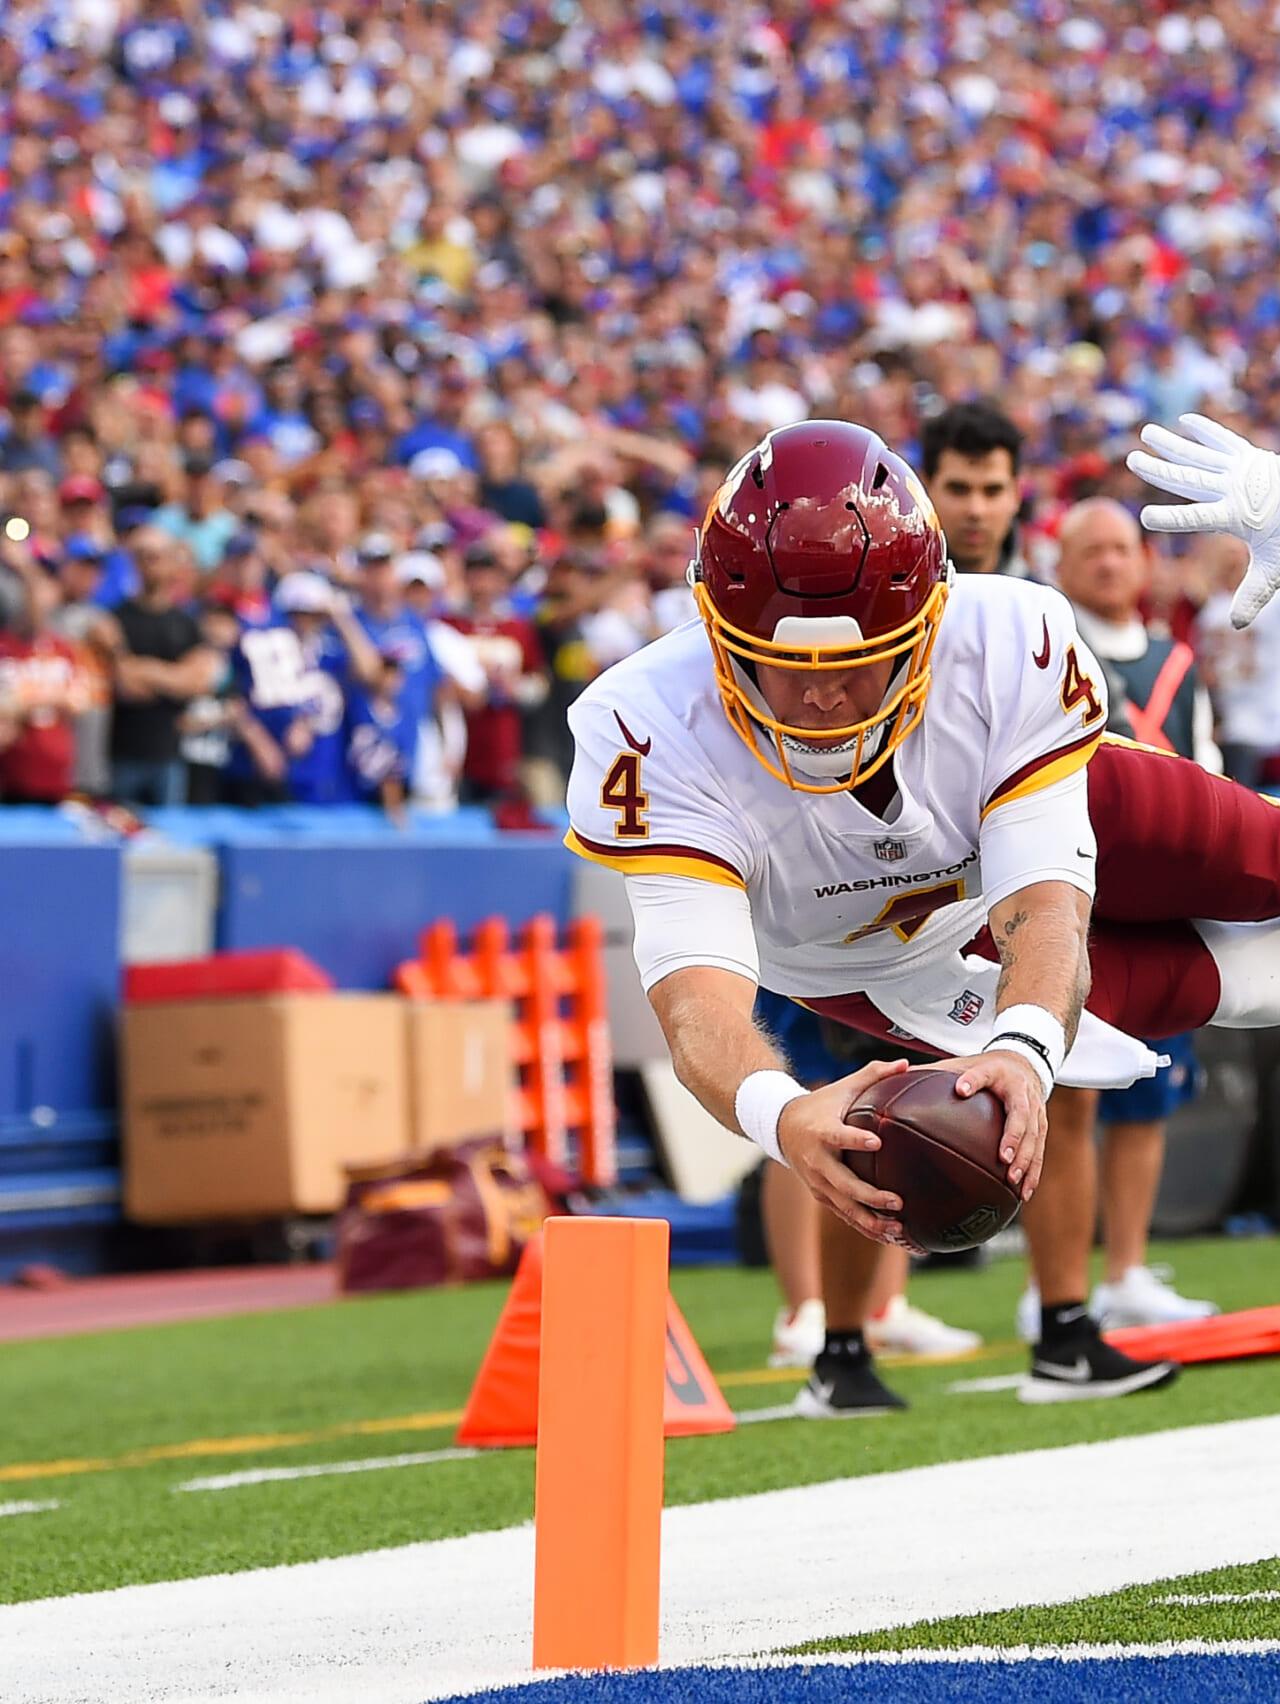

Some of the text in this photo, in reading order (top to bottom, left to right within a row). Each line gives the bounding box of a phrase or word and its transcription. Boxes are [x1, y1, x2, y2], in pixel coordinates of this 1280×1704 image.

[1058, 643, 1104, 727] 4
[599, 751, 649, 839] 4
[813, 850, 979, 899] WASHINGTON
[959, 999, 983, 1023] NFL
